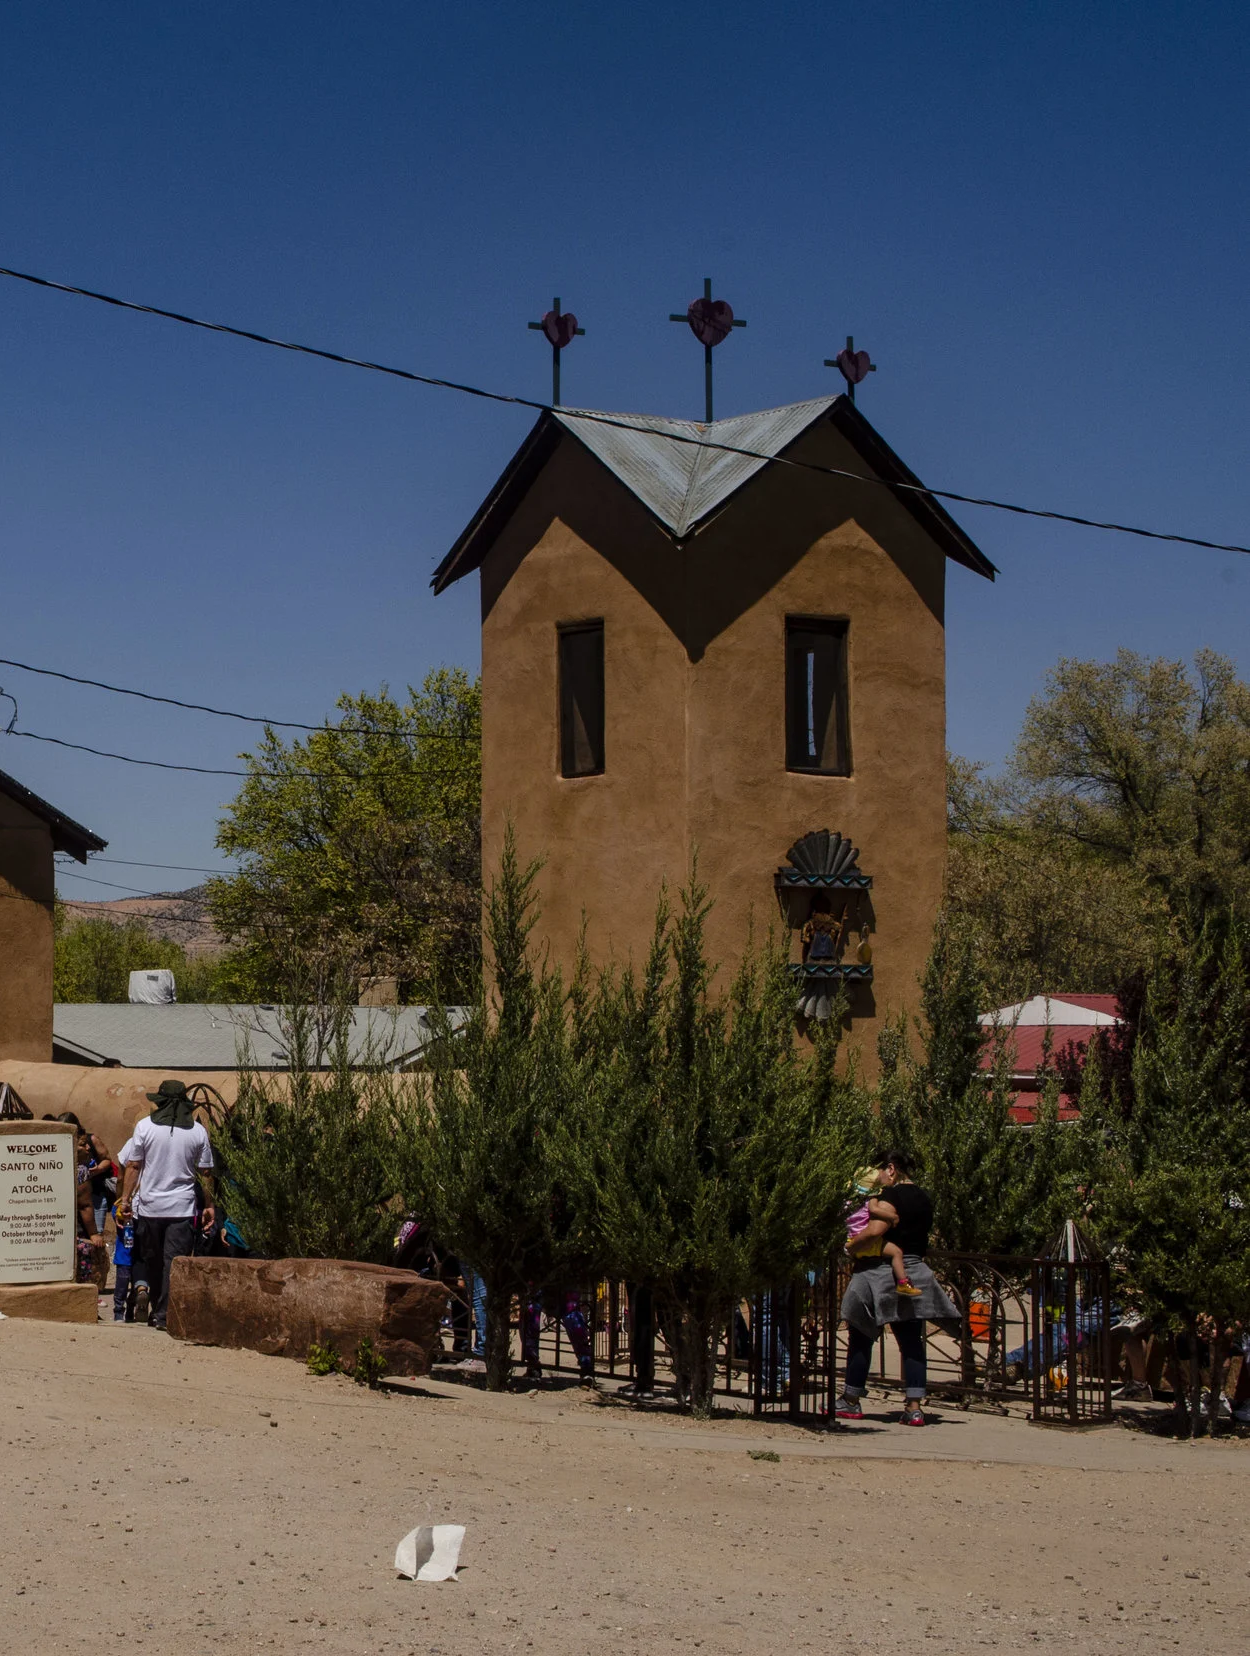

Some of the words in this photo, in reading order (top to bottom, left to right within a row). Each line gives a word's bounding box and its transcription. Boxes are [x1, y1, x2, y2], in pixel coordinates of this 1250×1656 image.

[6, 1144, 58, 1154] WELCOME
[0, 1162, 35, 1171] SANTO
[38, 1160, 64, 1170] NIÑO
[26, 1174, 38, 1182] de
[11, 1184, 54, 1194] ATOCHA
[11, 1214, 34, 1222] through
[35, 1213, 66, 1221] September
[1, 1230, 25, 1238] October
[26, 1230, 48, 1238] through
[50, 1228, 64, 1236] April
